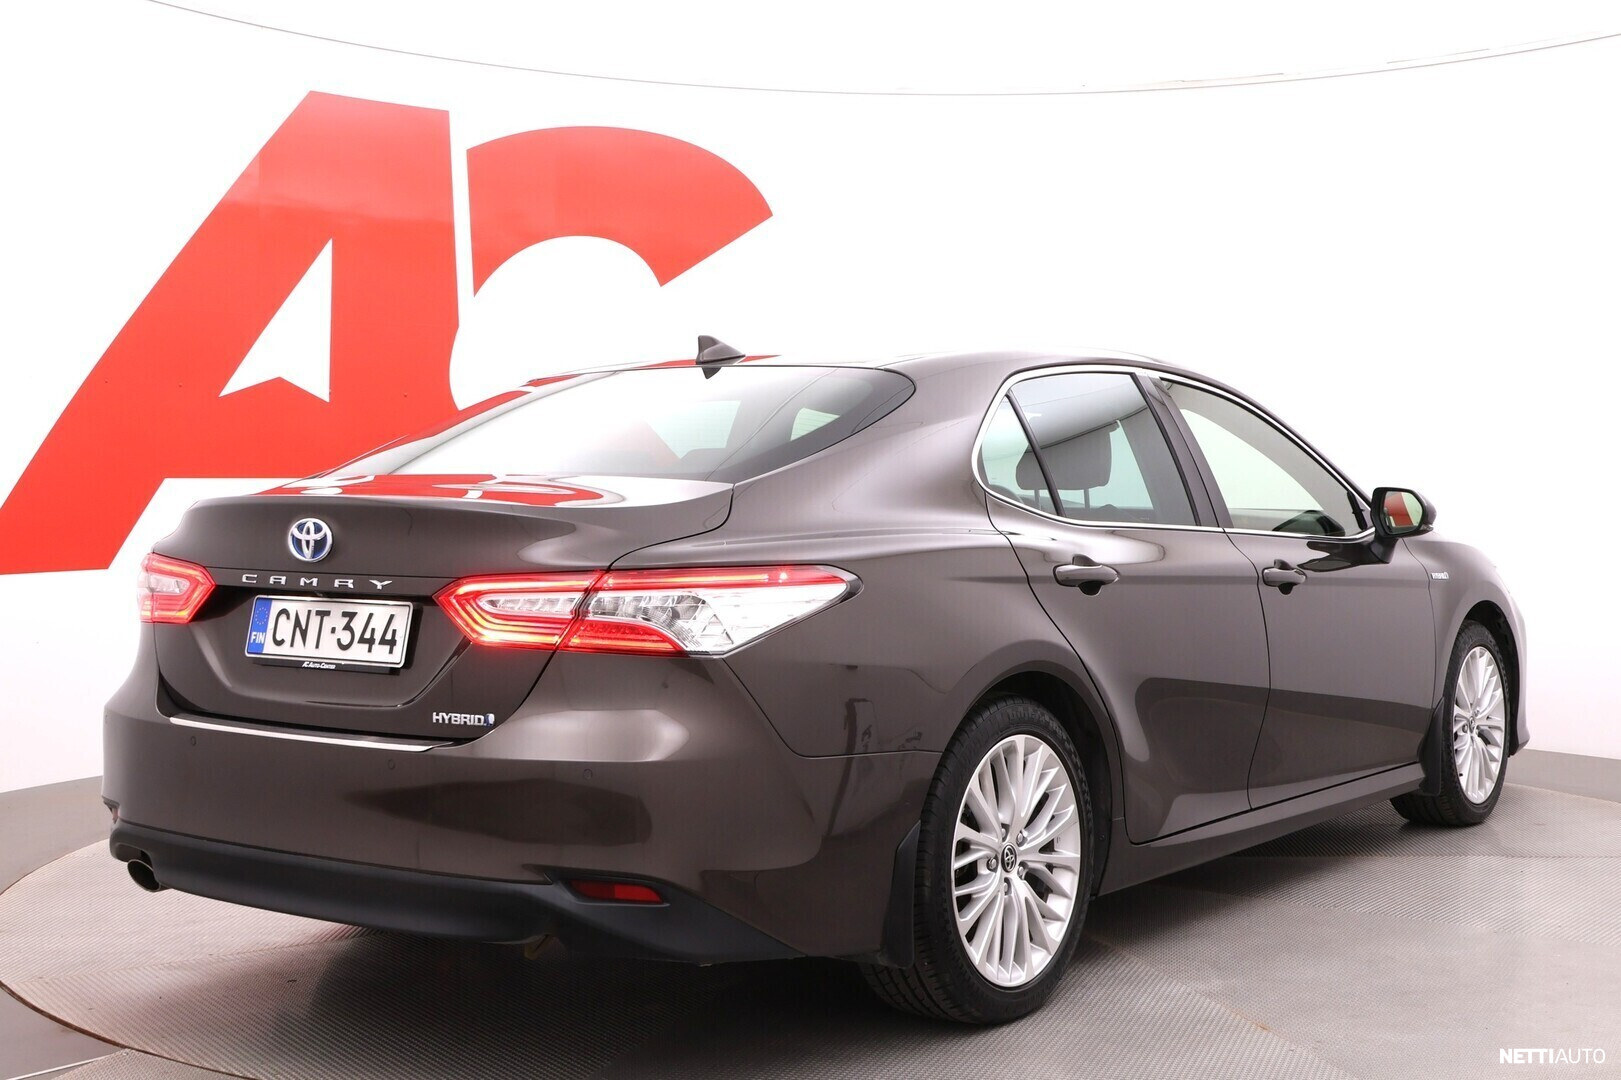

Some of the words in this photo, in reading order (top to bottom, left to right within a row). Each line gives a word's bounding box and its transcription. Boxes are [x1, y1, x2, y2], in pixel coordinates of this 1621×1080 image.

[242, 573, 393, 590] CAMRY
[250, 631, 266, 644] FIN
[272, 607, 398, 655] CNT-344
[432, 711, 485, 726] HYBRID
